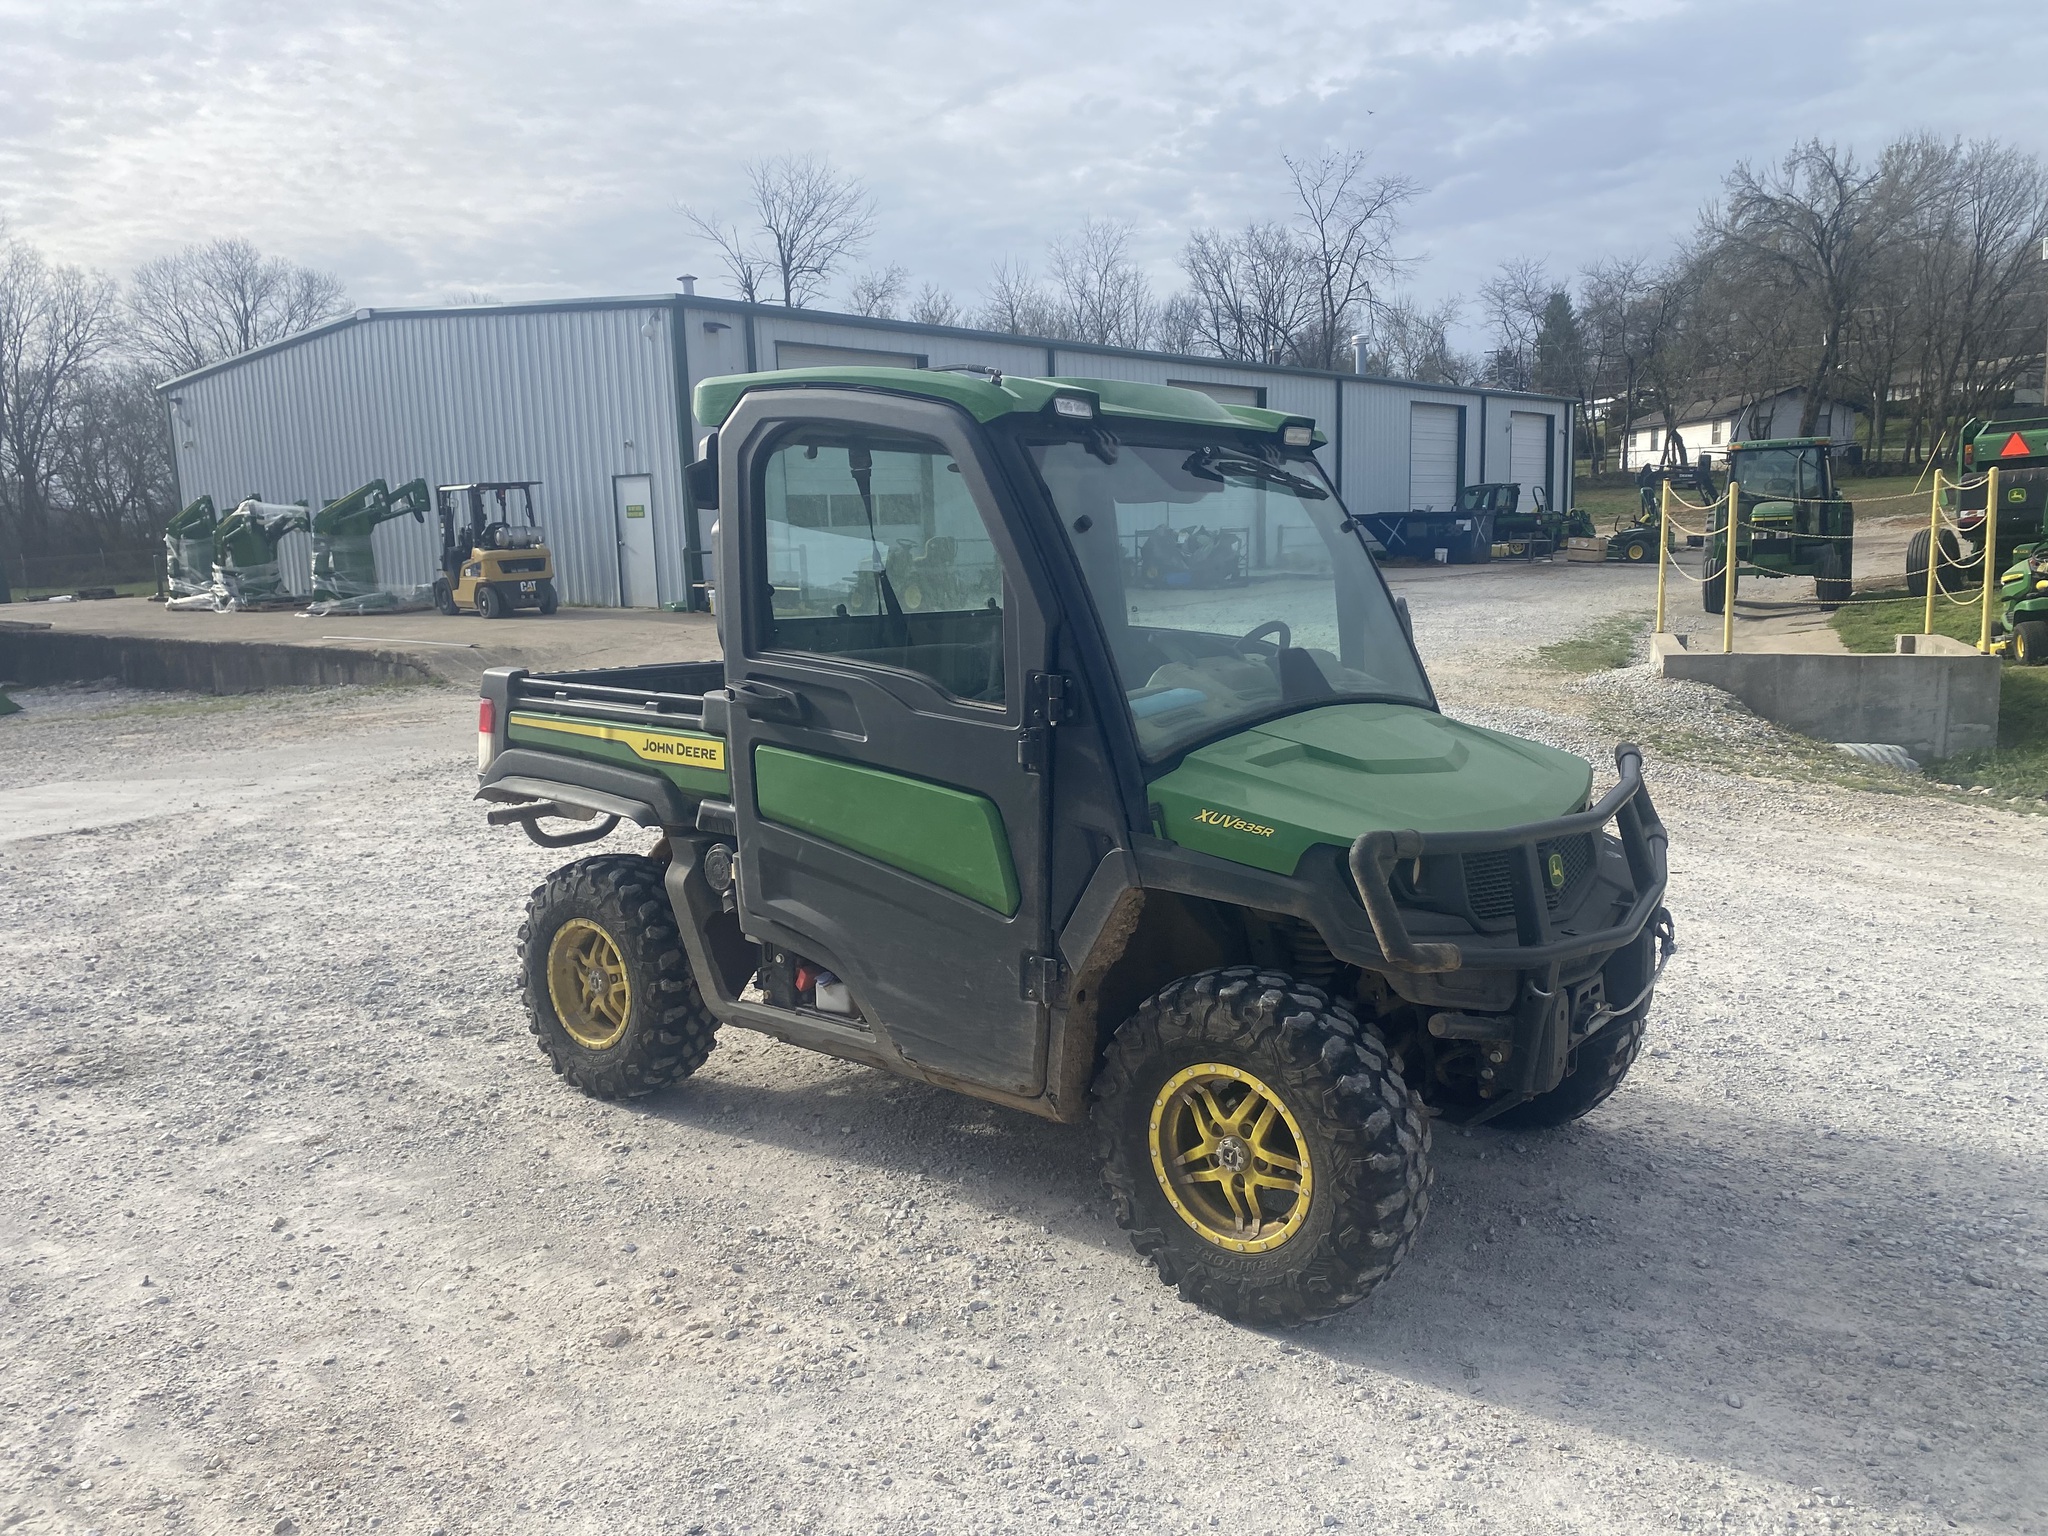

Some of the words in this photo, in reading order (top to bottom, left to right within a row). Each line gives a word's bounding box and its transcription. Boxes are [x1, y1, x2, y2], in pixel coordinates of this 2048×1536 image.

[520, 581, 536, 592] CAT
[642, 739, 674, 755] JOHN
[676, 742, 717, 760] DEERE
[1192, 808, 1275, 838] XUV835R
